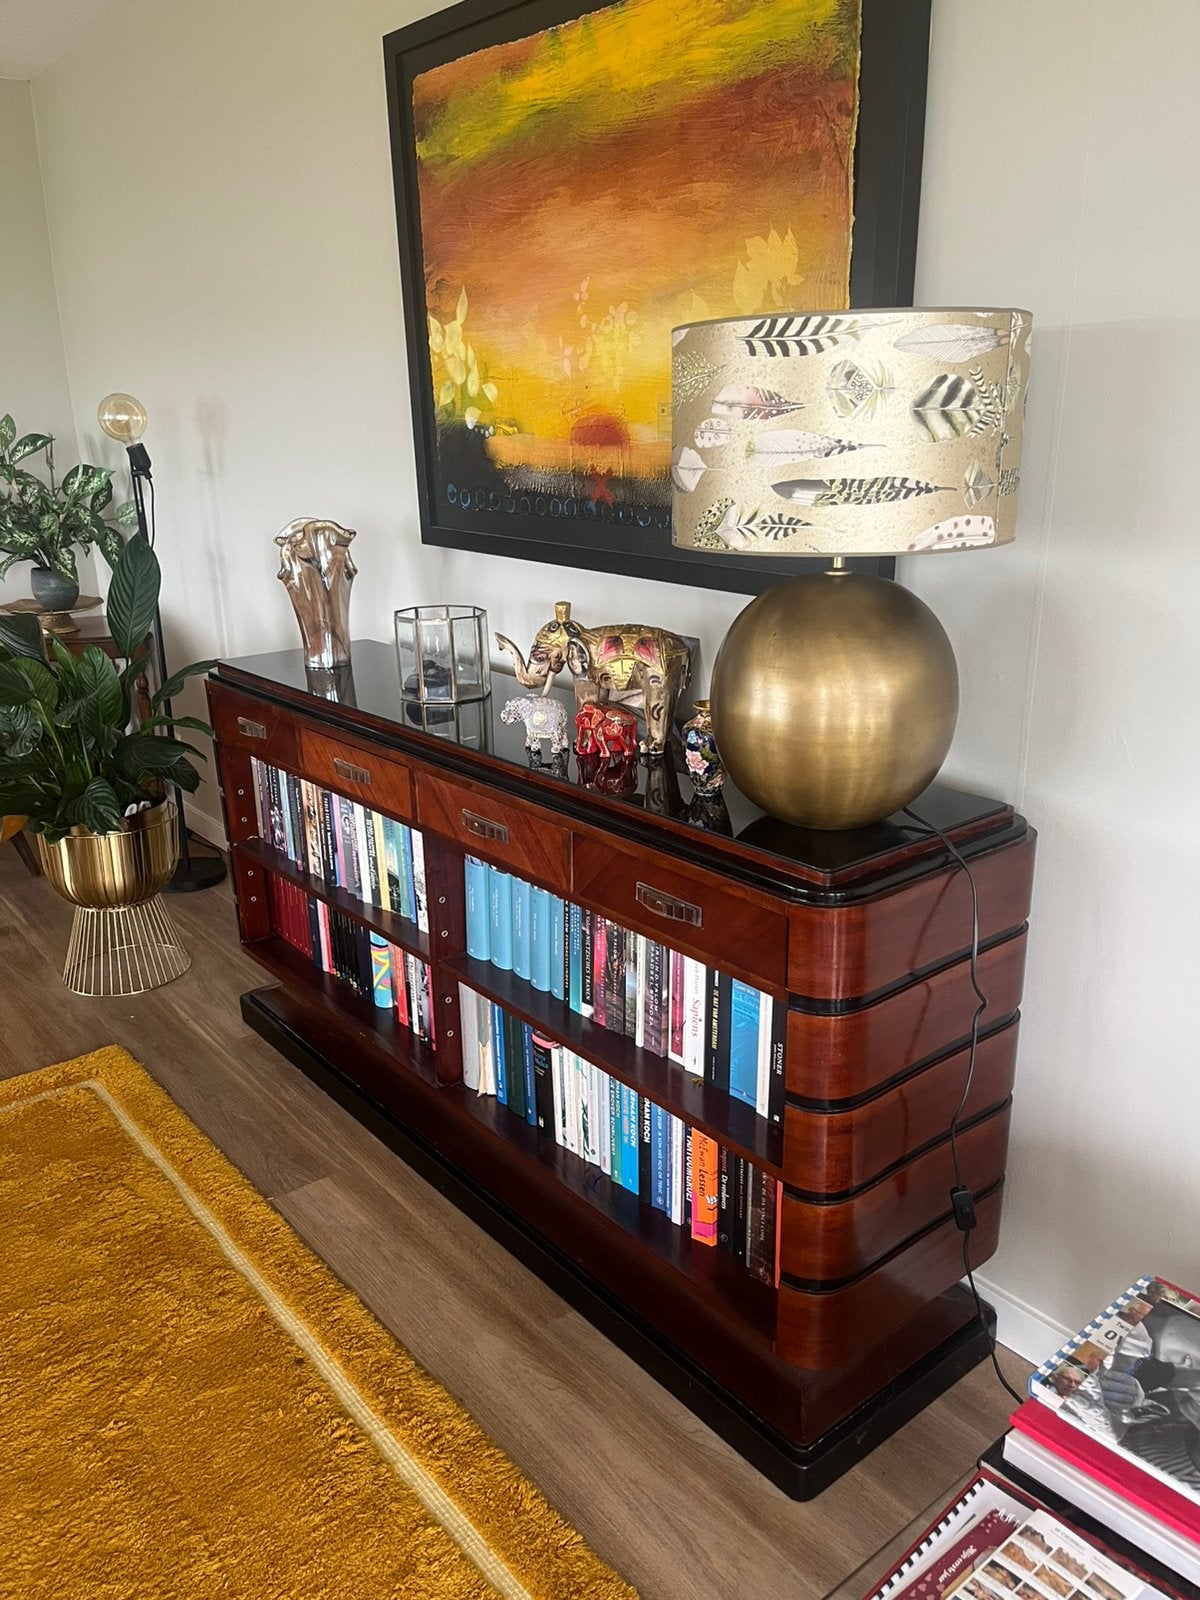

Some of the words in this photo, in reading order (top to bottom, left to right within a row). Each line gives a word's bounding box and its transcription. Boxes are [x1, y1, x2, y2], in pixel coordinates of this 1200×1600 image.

[689, 997, 702, 1038] Sapiens
[712, 996, 720, 1008] RAT
[712, 1007, 720, 1018] VAN
[711, 1018, 719, 1050] AMSTERDAM
[776, 1042, 785, 1075] STONER
[643, 1119, 651, 1143] KOCH
[699, 1136, 709, 1168] McEwan
[699, 1168, 710, 1198] Lessen
